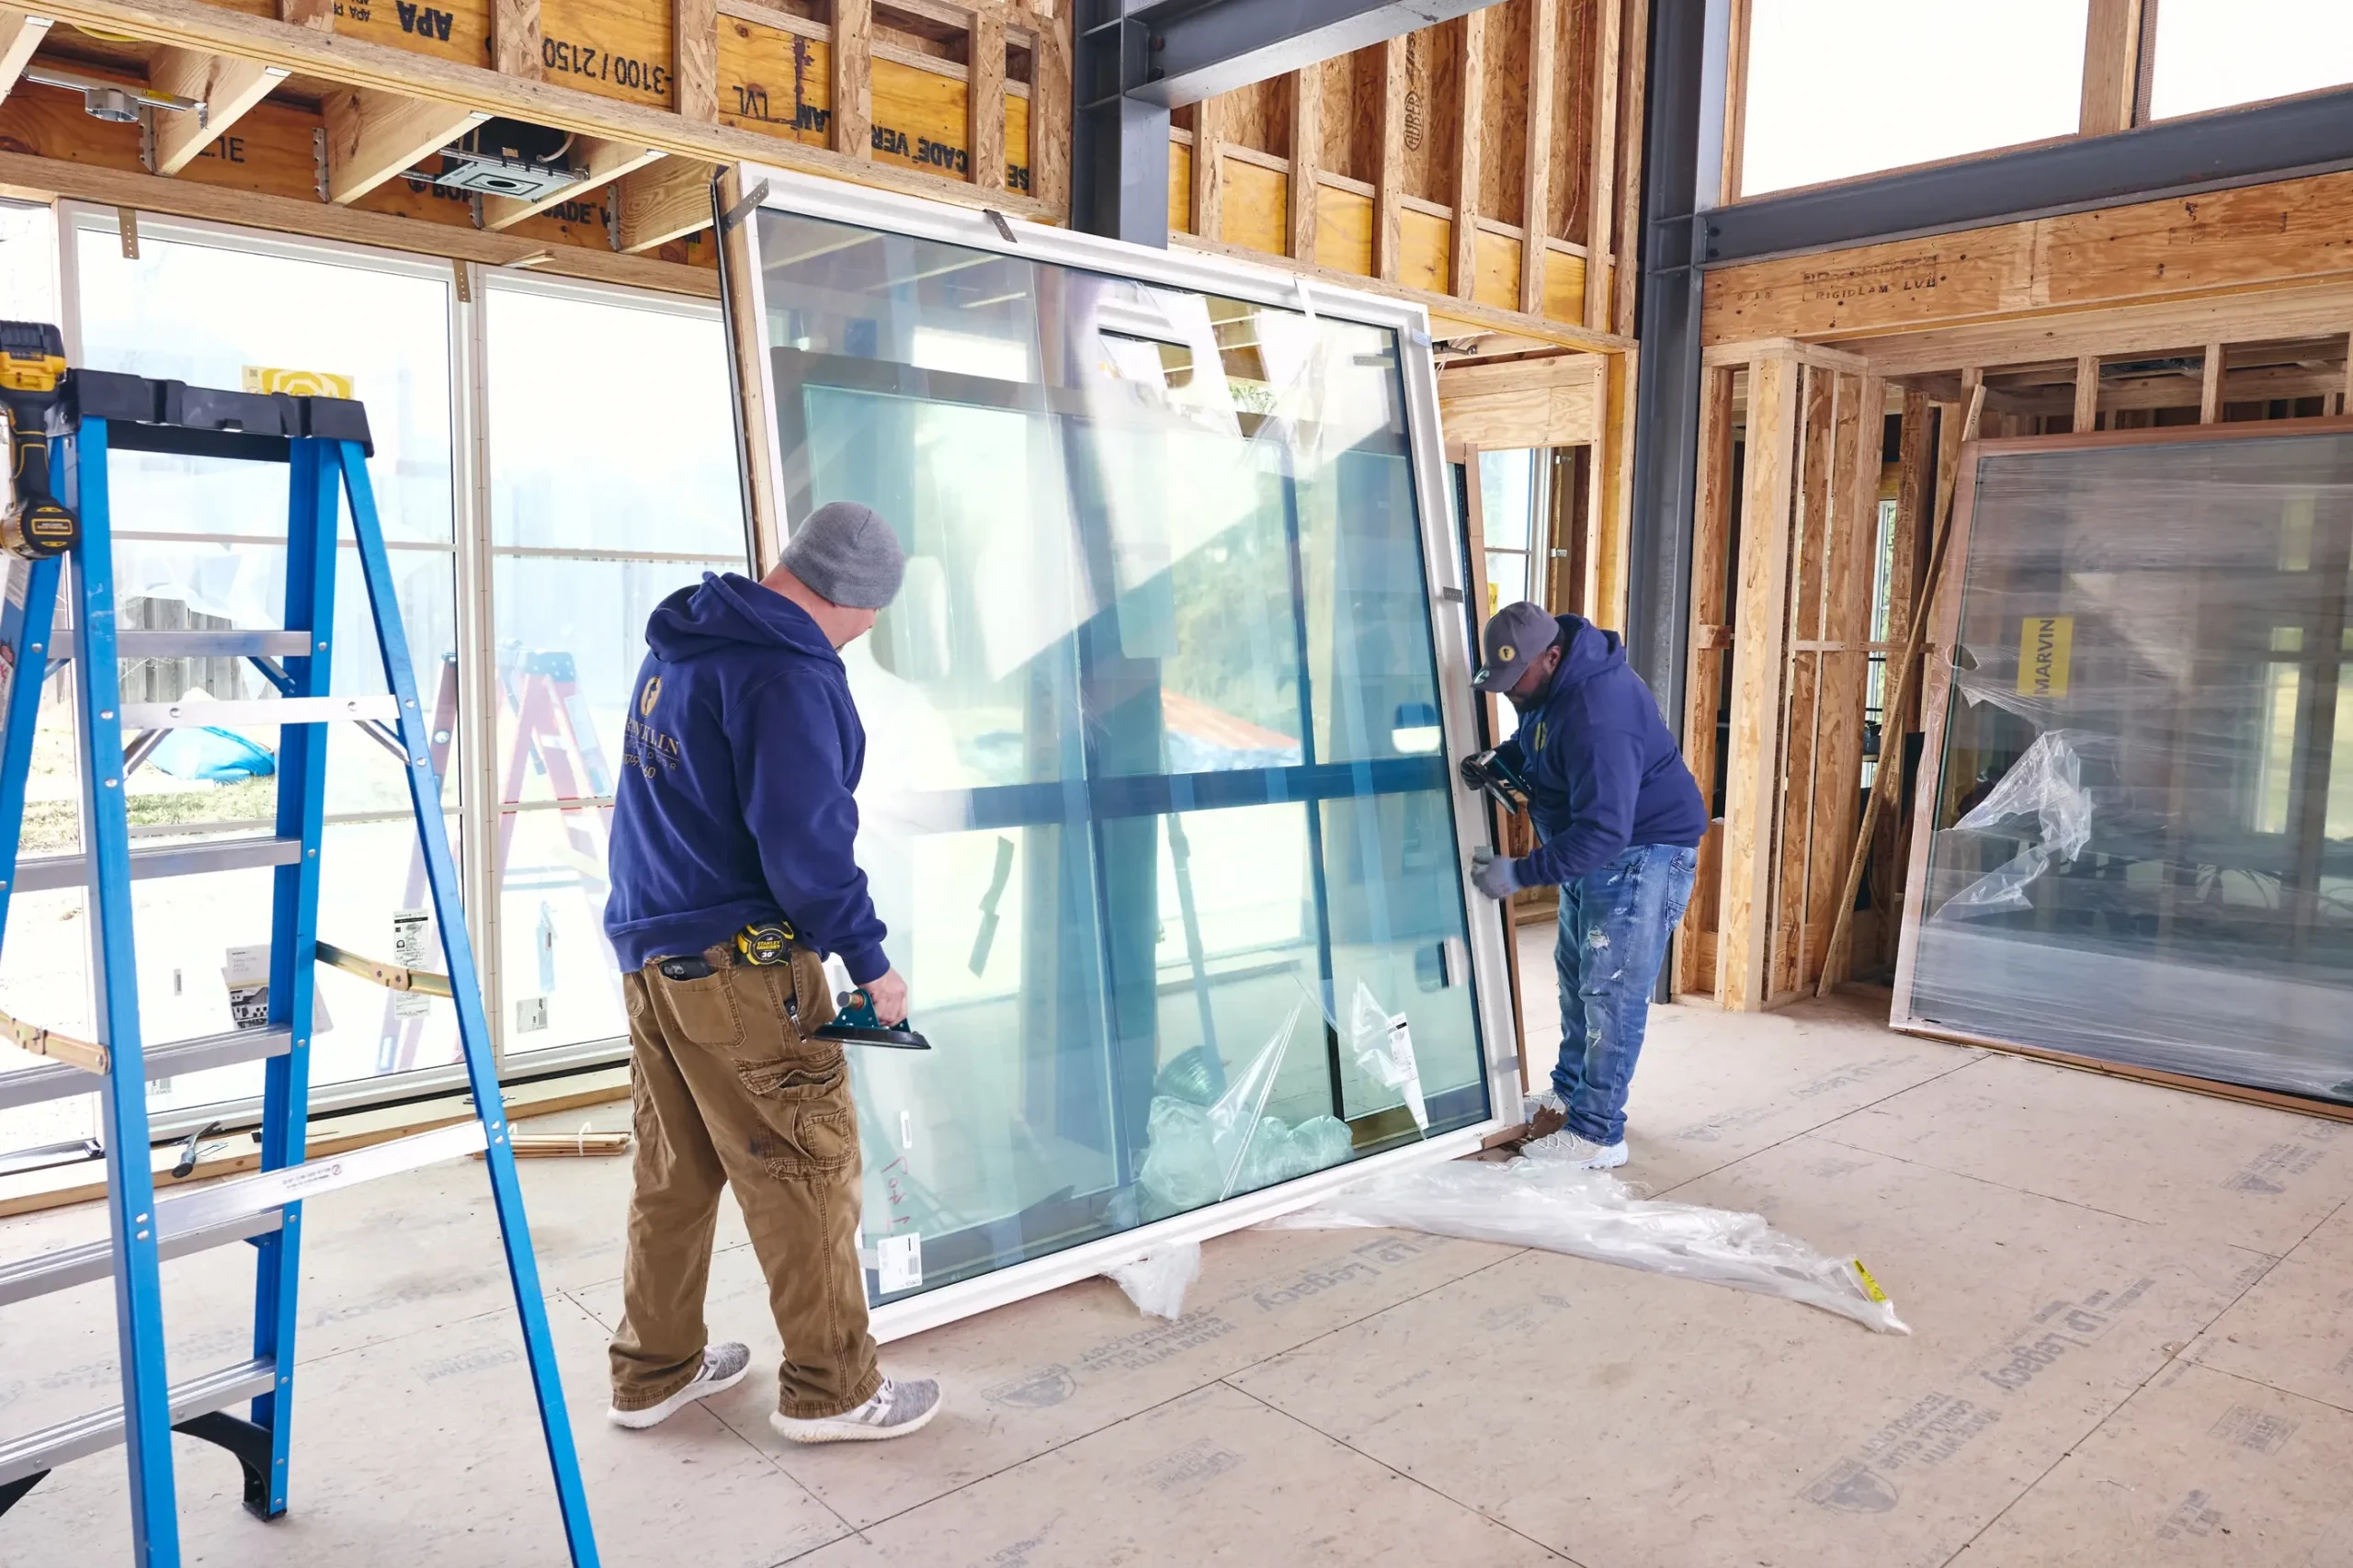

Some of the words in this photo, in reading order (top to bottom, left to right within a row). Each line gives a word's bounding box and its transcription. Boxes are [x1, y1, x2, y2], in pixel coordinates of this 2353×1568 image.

[395, 0, 453, 41] APA
[733, 85, 767, 120] LVL
[1404, 97, 1421, 145] HUBER
[199, 135, 244, 163] .1E
[1816, 285, 1889, 300] RIGIDLAM
[2034, 619, 2055, 694] MARVIN
[1253, 1262, 1382, 1312] Legacy
[1980, 1332, 2091, 1392] Legacy
